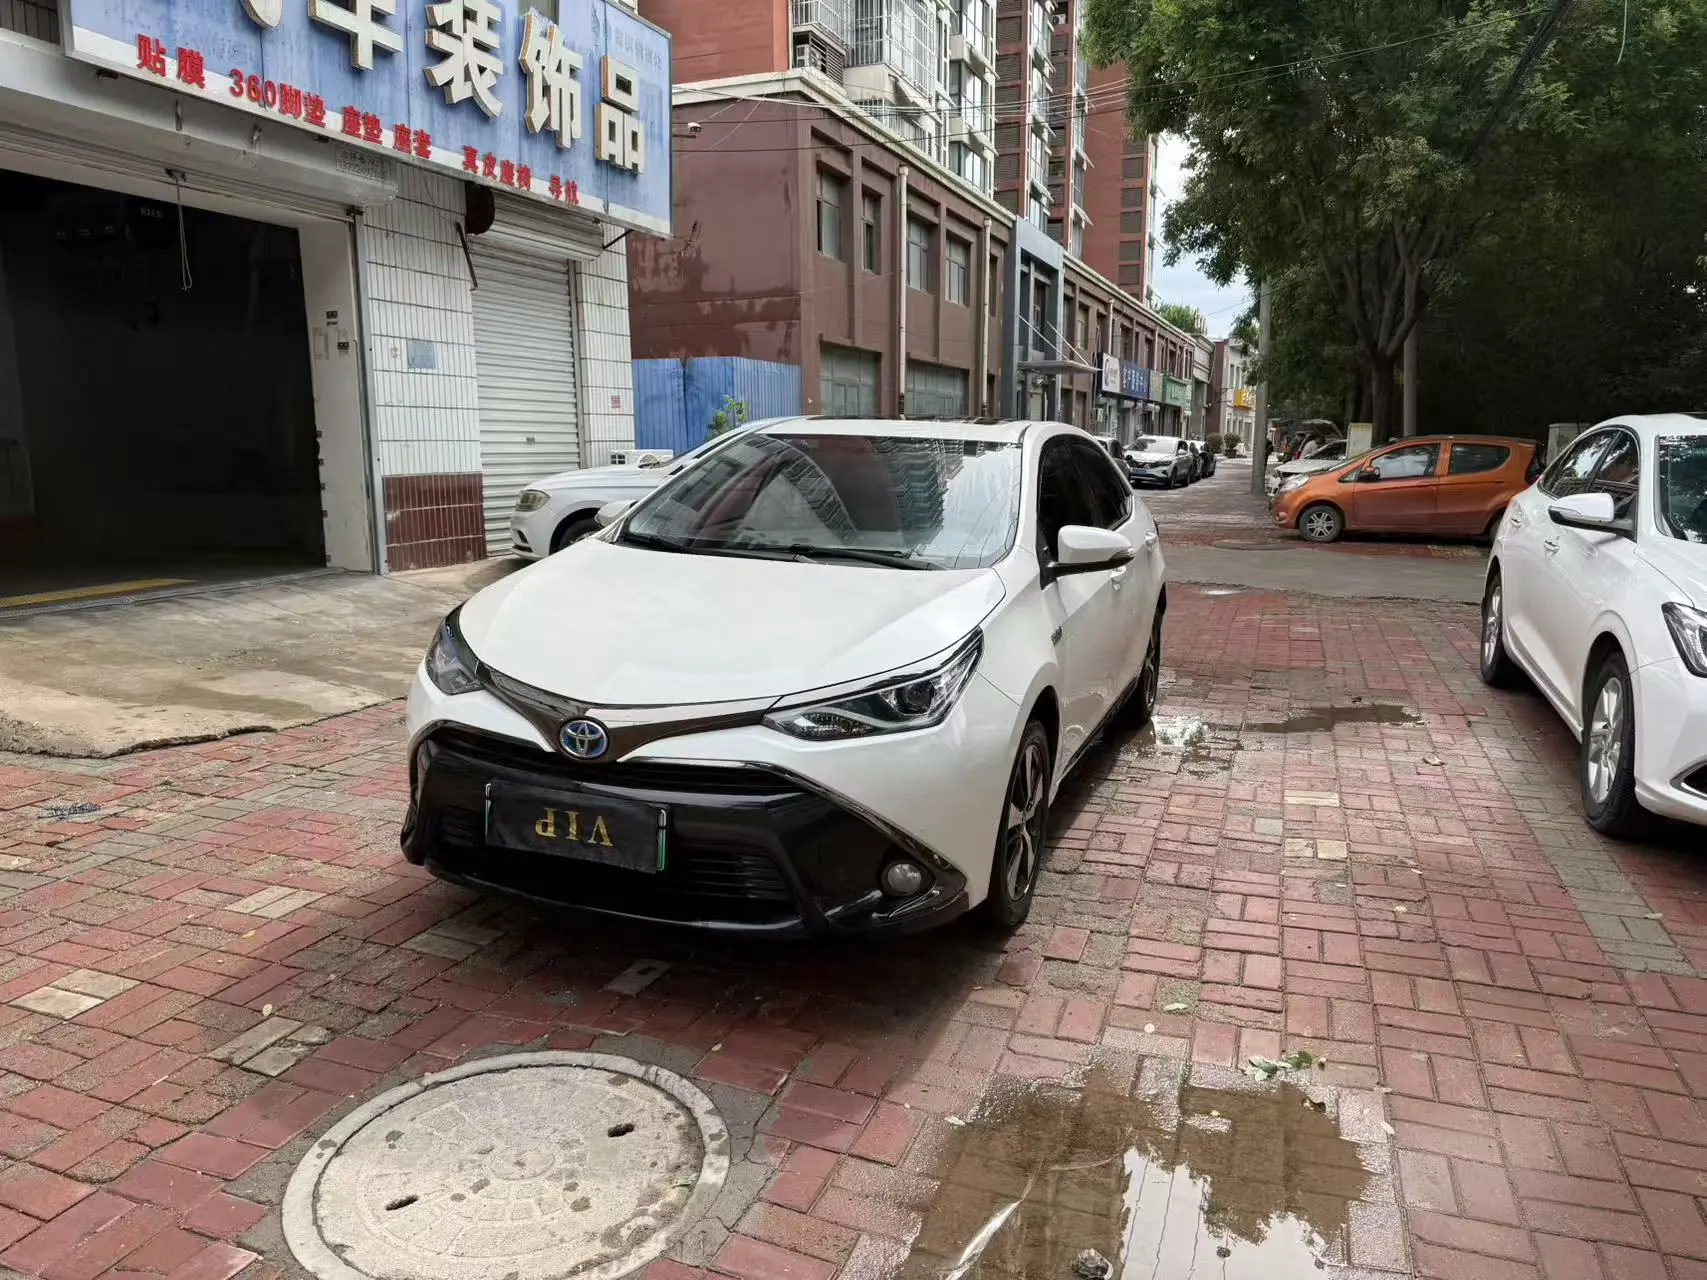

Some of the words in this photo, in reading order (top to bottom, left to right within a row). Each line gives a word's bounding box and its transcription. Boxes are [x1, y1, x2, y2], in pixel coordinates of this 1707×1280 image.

[241, 0, 645, 174] 装饰品
[535, 807, 613, 847] VIP
